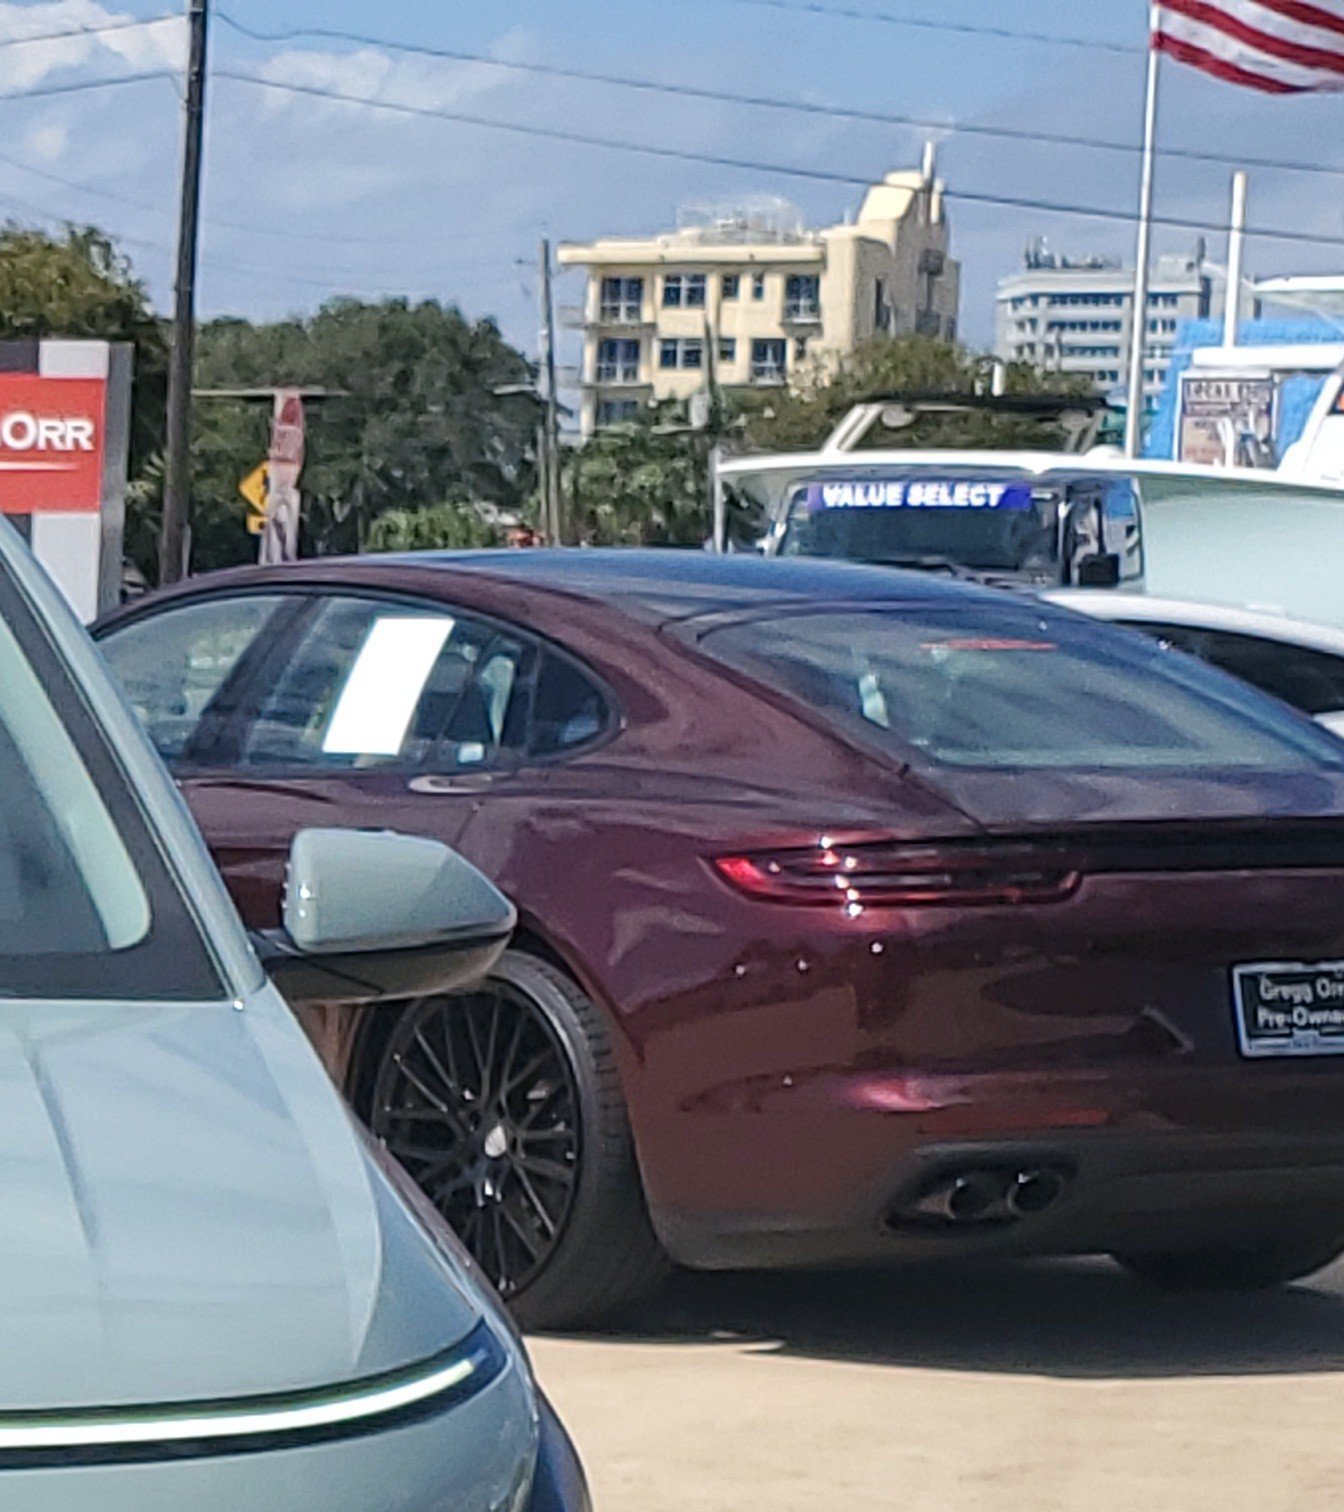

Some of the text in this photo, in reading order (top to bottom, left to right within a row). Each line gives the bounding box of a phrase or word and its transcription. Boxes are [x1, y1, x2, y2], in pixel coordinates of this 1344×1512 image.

[0, 411, 95, 451] ORR
[822, 483, 1004, 507] VALUE SELECT
